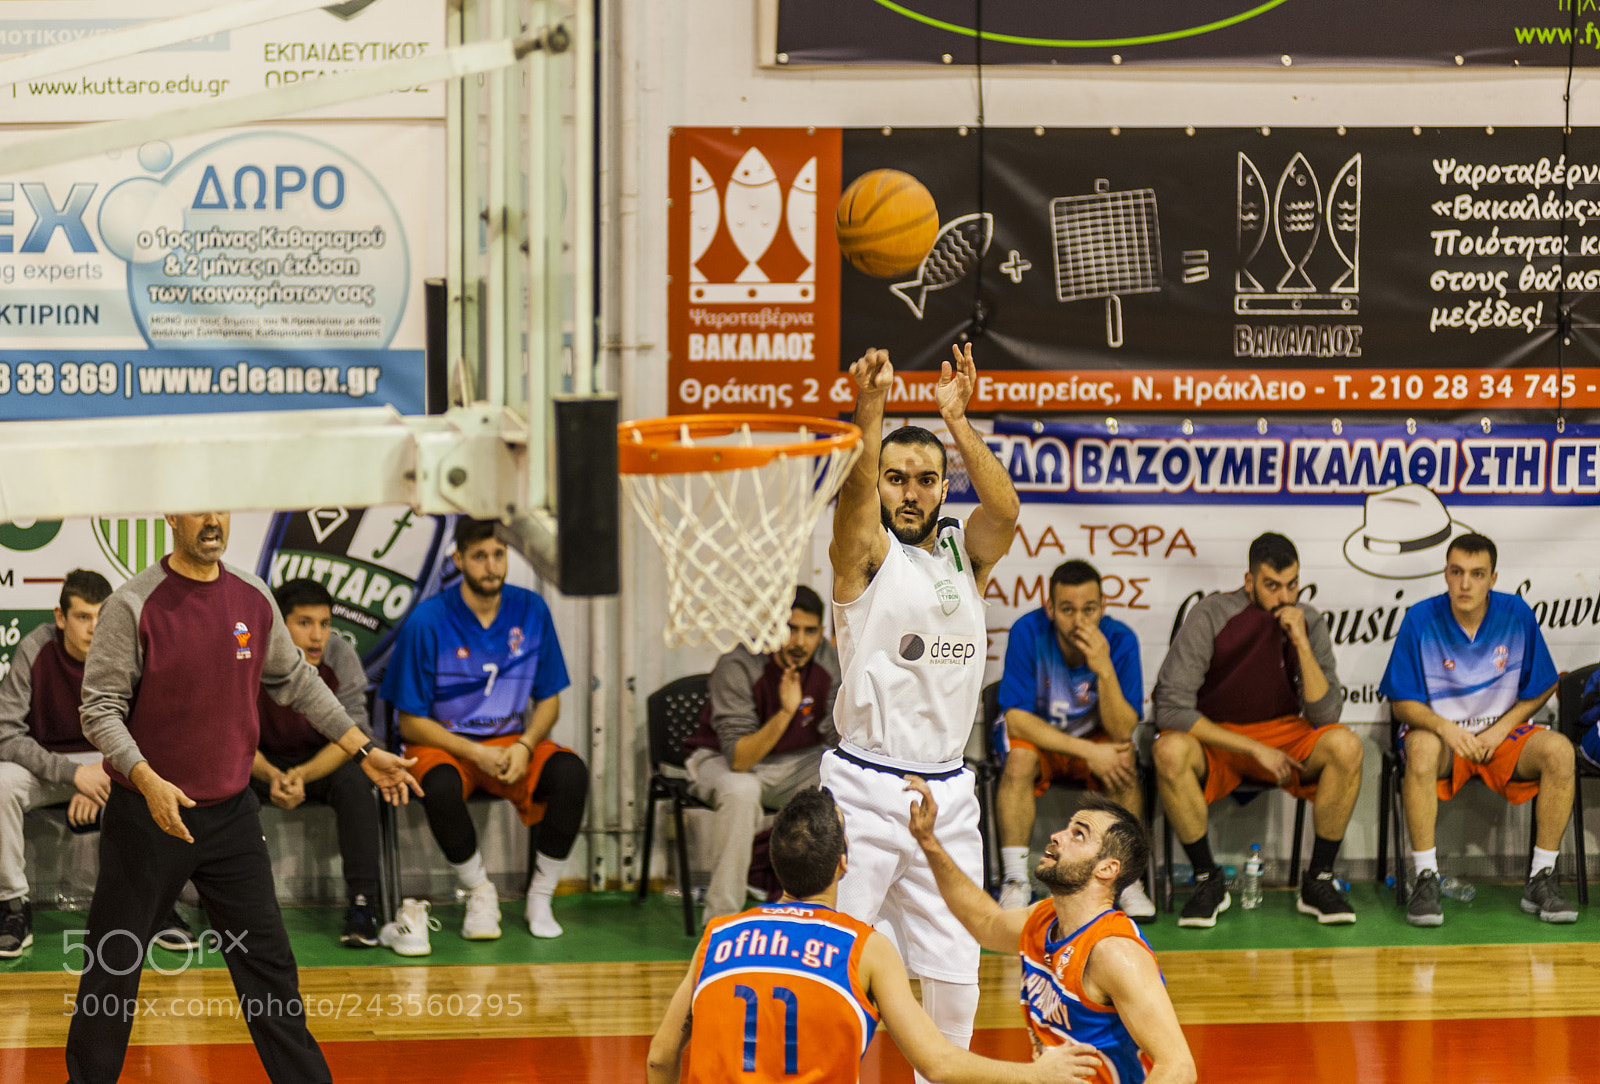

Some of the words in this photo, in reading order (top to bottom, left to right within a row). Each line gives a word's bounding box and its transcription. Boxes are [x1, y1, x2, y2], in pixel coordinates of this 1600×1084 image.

[28, 75, 231, 97] www.kuttaro.edu.gr
[191, 165, 345, 210] ΔΩΡΟ
[1432, 154, 1600, 191] Ψαροταβέρν
[195, 226, 258, 252] μήνας
[259, 225, 386, 252] Καθαρισμού
[1580, 235, 1600, 256] κ
[24, 262, 103, 284] experts
[164, 254, 182, 276] &
[184, 254, 199, 276] 2
[202, 252, 263, 281] μήνες
[283, 252, 360, 278] έκδοση
[148, 284, 188, 303] των
[191, 280, 334, 308] κοινοχρήστων
[335, 284, 375, 307] σας
[1430, 270, 1509, 299] στους
[689, 307, 815, 330] Ψαροταβέρνα
[1430, 297, 1544, 334] μεζέδες!
[689, 333, 815, 361] ΒΑΚΑΛΑΟΣ
[1234, 325, 1363, 357] ΒΑΚΑΛΑΟΣ
[15, 362, 55, 396] 33
[60, 362, 119, 396] 369
[138, 362, 382, 396] www.cleanex.gr
[679, 377, 794, 409] Θράκης
[801, 378, 820, 403] 2
[829, 378, 854, 403] &
[979, 375, 1121, 405] Εταιρείας,
[1133, 376, 1163, 401] Ν.
[1174, 374, 1306, 407] Ηράκλειο
[1334, 375, 1359, 400] Τ.
[1369, 374, 1424, 400] 210
[1433, 374, 1469, 400] 28
[1479, 374, 1514, 400] 34
[1524, 374, 1577, 399] 745
[1081, 444, 1278, 485] ΒΑΖΟΥΜΕ
[1294, 445, 1450, 486] ΚΑΛΑΘΙ
[1466, 445, 1541, 486] ΣΤΗ
[1080, 523, 1198, 559] ΤΩΡΑ
[930, 635, 976, 666] deep
[482, 662, 499, 697] 7
[713, 928, 840, 969] ofhh.gr
[733, 984, 799, 1076] 11
